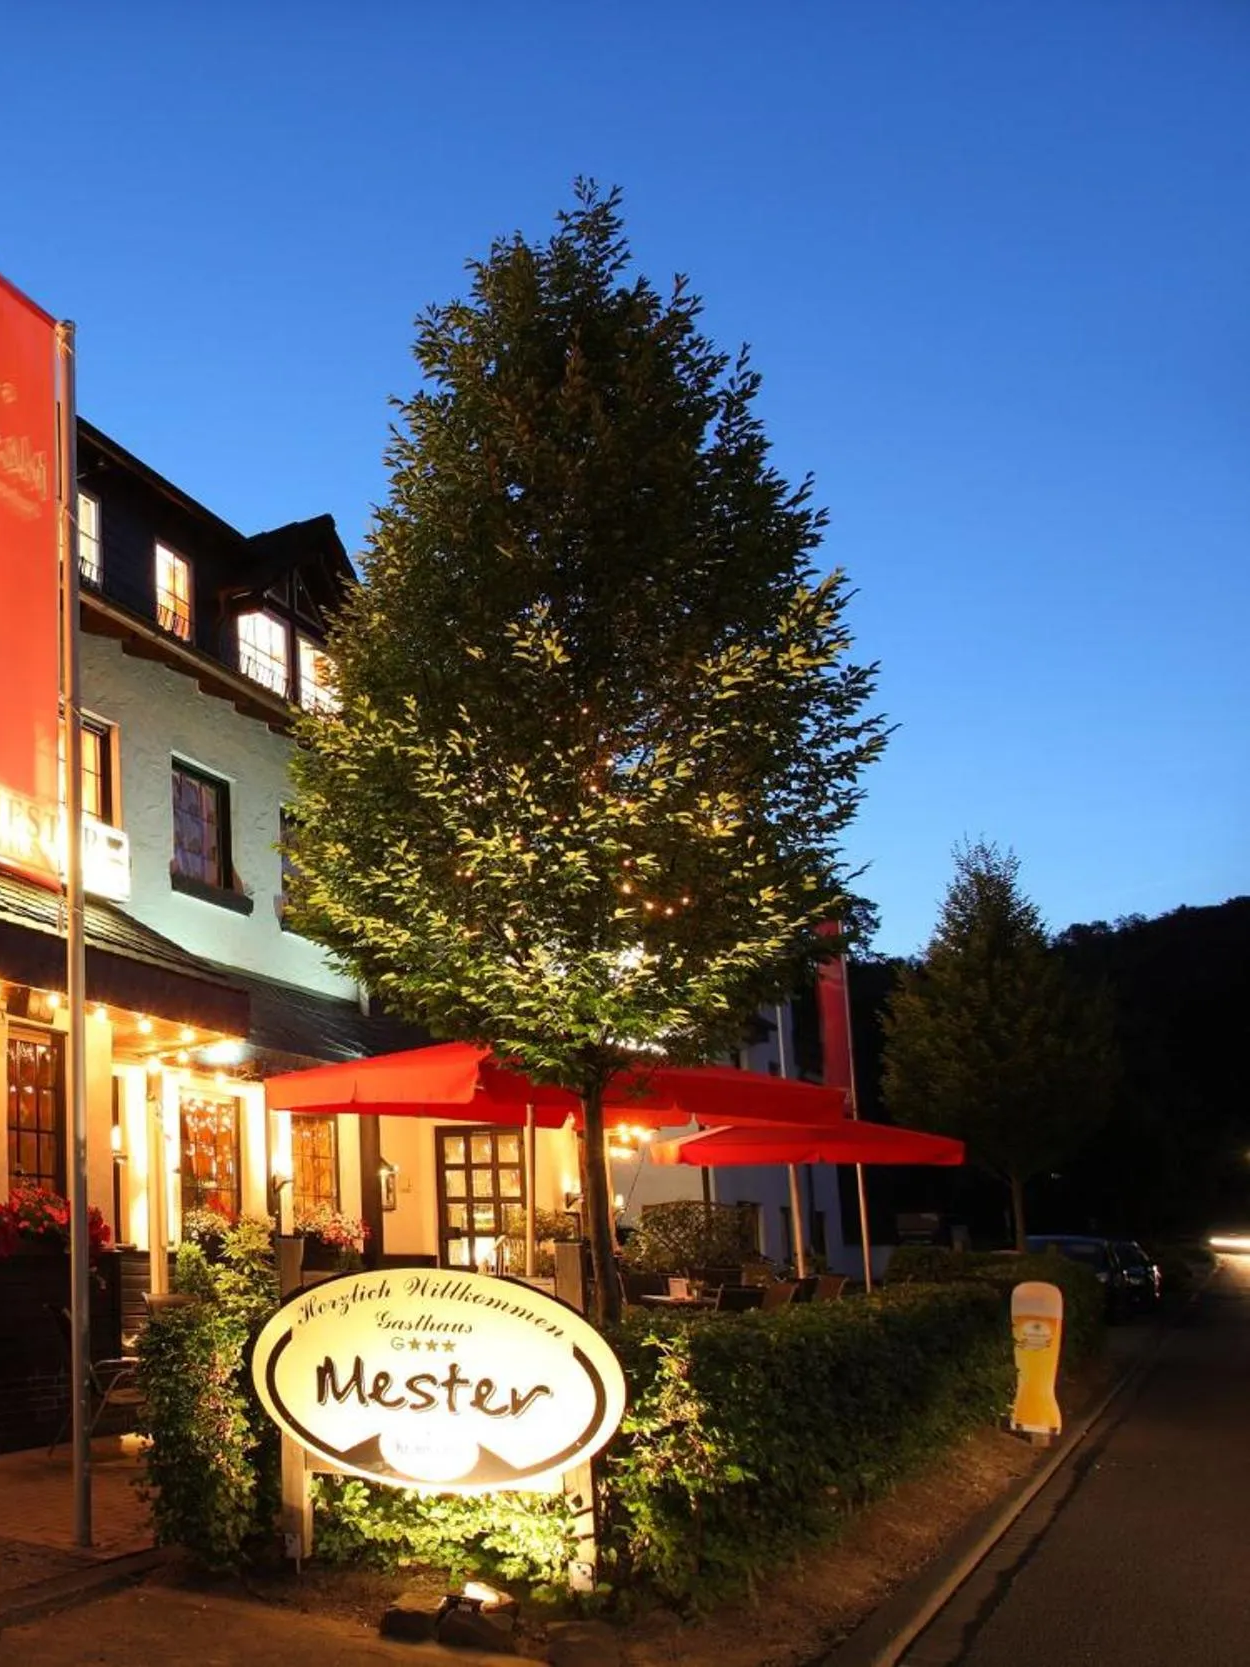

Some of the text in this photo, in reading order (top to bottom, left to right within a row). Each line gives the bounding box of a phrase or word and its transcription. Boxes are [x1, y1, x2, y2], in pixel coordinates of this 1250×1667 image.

[297, 1275, 565, 1340] Herzlich Willkommen
[374, 1309, 474, 1334] Gasthaus
[316, 1354, 554, 1420] Mester
